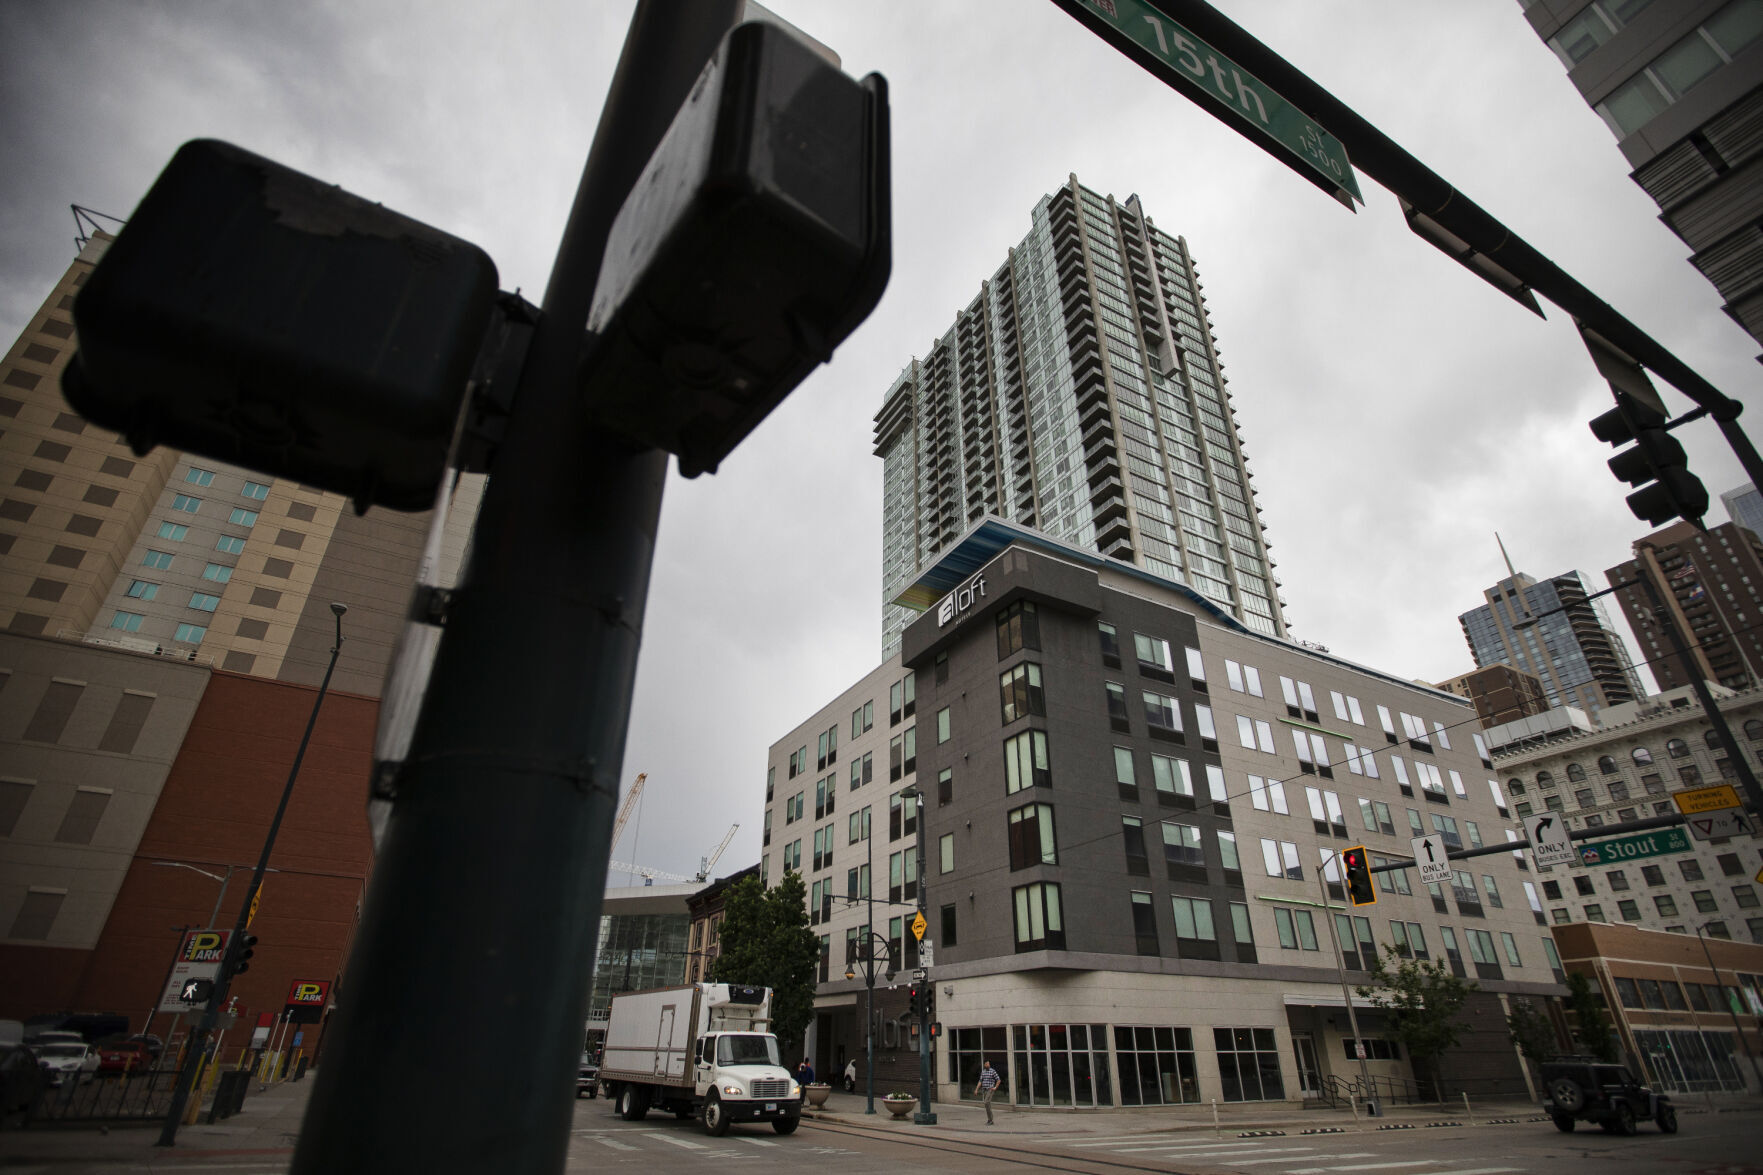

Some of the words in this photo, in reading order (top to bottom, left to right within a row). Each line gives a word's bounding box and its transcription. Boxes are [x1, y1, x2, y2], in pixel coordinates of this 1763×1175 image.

[1143, 15, 1269, 124] 15th
[1299, 136, 1342, 176] 1500
[938, 573, 986, 627] aloft
[1687, 791, 1723, 801] TURNING
[1689, 799, 1730, 810] VEHICLES
[1669, 833, 1679, 841] St
[1538, 841, 1566, 855] ONLY
[1605, 836, 1659, 859] Stout
[1667, 840, 1685, 849] 800
[1422, 862, 1445, 873] ONLY
[1422, 874, 1434, 882] BUS
[1436, 871, 1452, 880] LANE
[189, 933, 223, 960] PARK
[298, 983, 322, 1001] PARK
